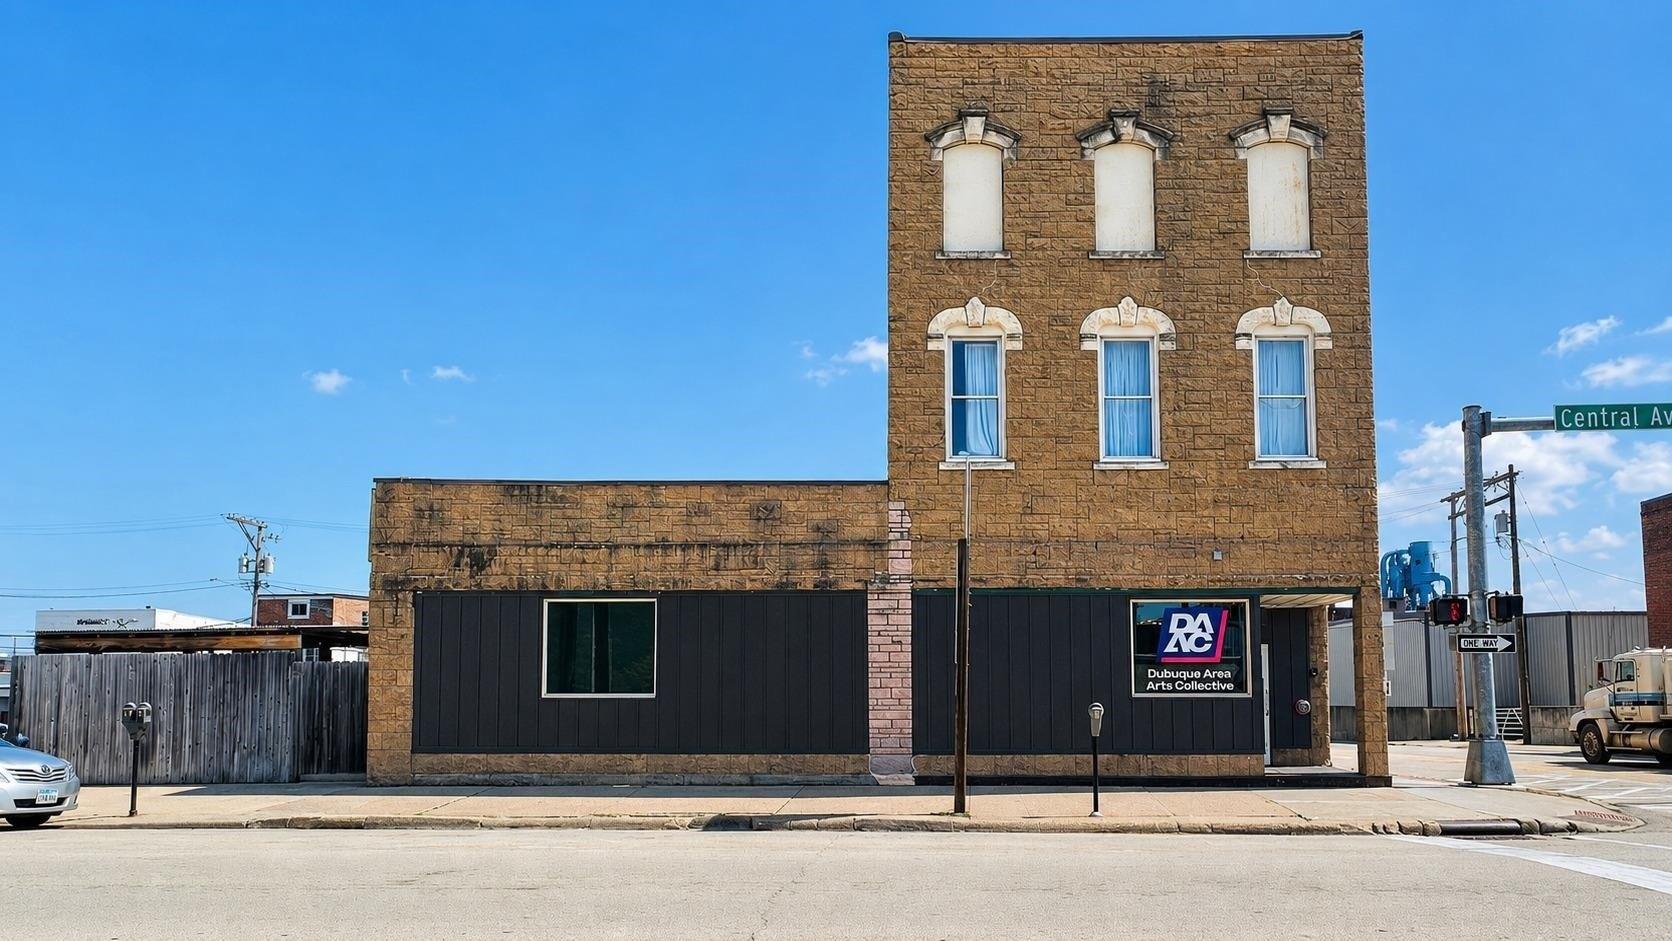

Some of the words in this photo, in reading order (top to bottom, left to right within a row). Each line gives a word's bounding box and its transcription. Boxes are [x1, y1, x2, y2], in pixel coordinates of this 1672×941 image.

[1561, 407, 1638, 428] Central
[1463, 639, 1479, 647] ONE
[1482, 639, 1498, 647] WAY
[1147, 668, 1201, 680] Dubuque
[1203, 669, 1231, 678] Area
[1146, 681, 1173, 690] Arts
[1175, 680, 1234, 690] Collective
